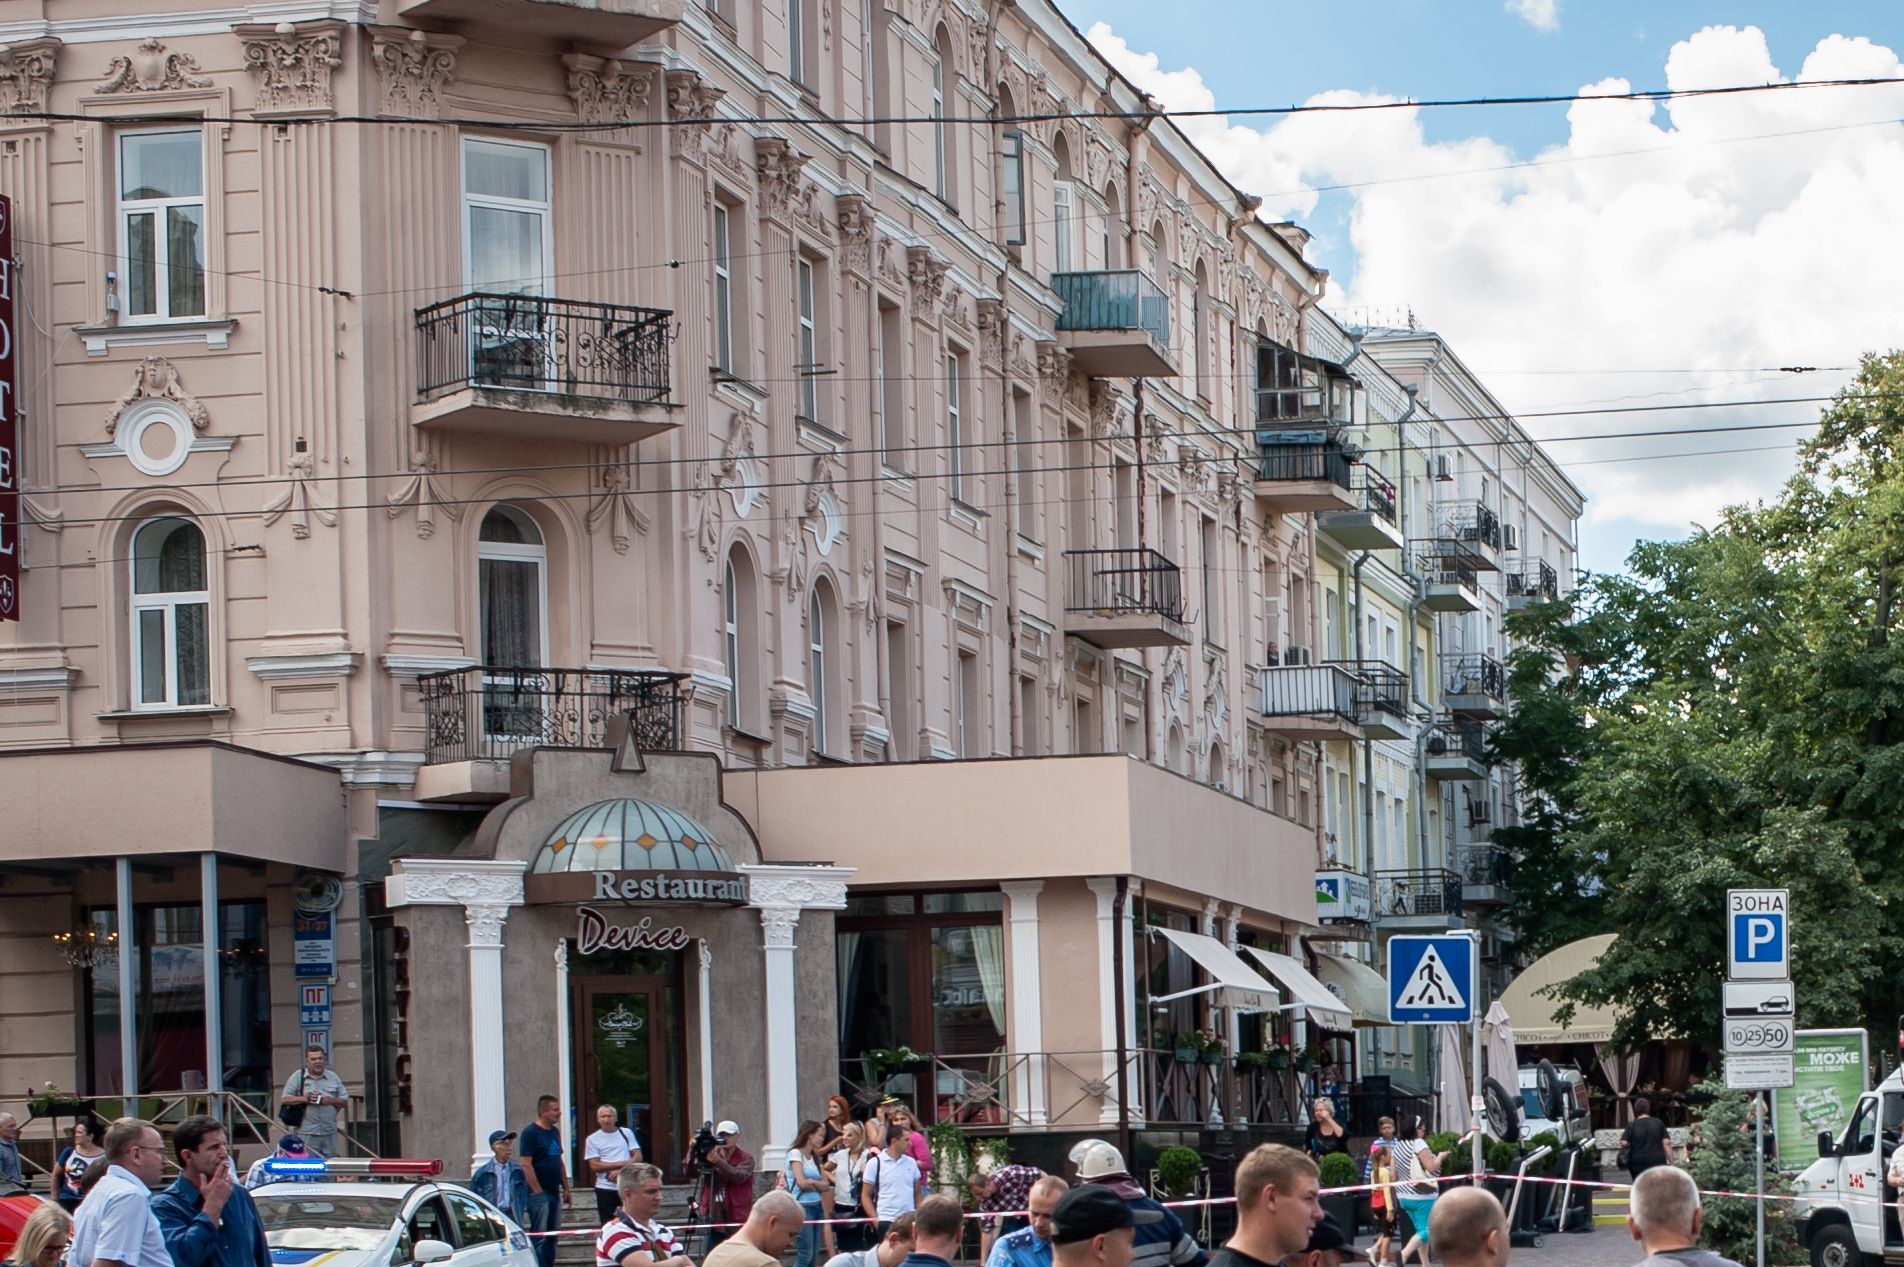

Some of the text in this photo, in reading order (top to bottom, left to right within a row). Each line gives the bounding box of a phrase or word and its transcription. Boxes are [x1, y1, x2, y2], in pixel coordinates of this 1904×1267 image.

[592, 871, 747, 900] Restaurant
[1732, 896, 1784, 912] ЗОНА
[577, 906, 689, 955] Device
[1747, 918, 1776, 959] P
[305, 988, 326, 1004] ПГ
[1731, 1028, 1784, 1043] 10 25 50
[1809, 1051, 1860, 1065] МОЖЕ
